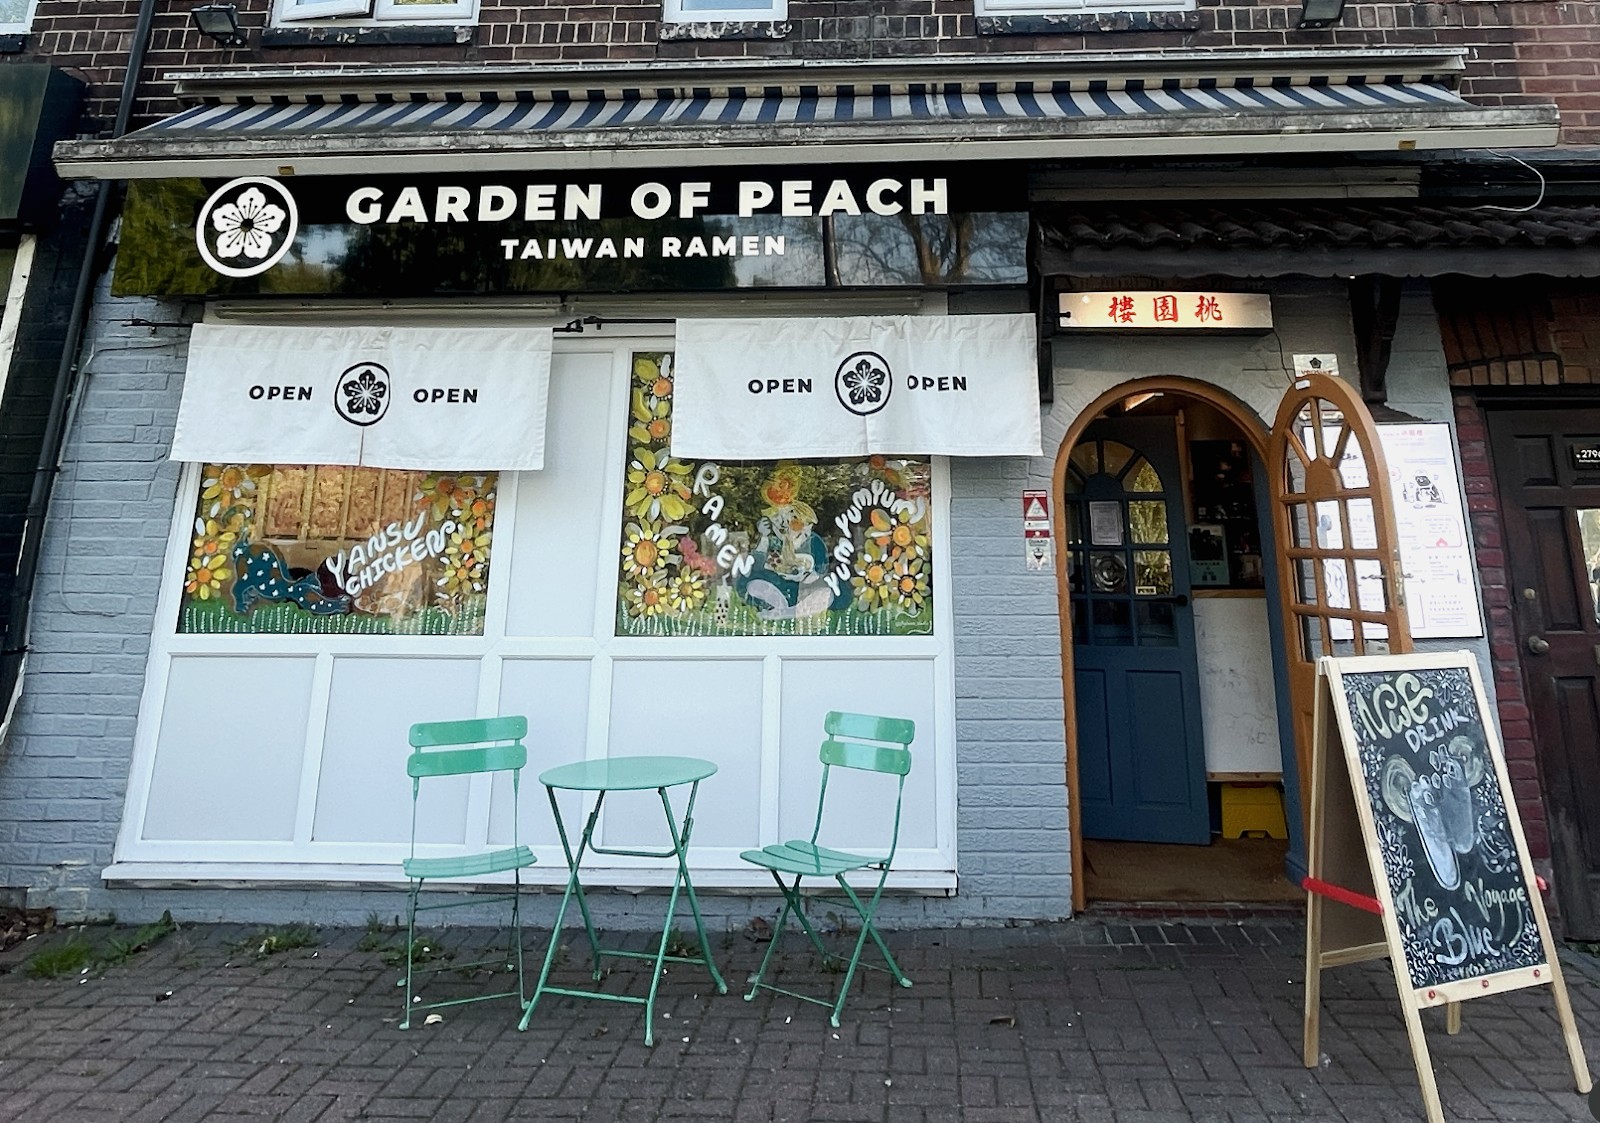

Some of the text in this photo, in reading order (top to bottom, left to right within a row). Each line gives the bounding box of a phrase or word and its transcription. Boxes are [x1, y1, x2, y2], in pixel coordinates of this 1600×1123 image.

[346, 178, 948, 224] GARDEN OF PEACH
[501, 234, 786, 261] TAIWAN RAMEN
[249, 385, 313, 402] OPEN
[413, 388, 478, 404] OPEN
[748, 377, 813, 395] OPEN
[907, 374, 967, 392] OPEN
[325, 510, 426, 590] YANSU
[344, 519, 457, 597] CHICKEN
[1404, 707, 1471, 753] DRINK
[1396, 878, 1439, 930] The
[1433, 906, 1501, 966] Blue
